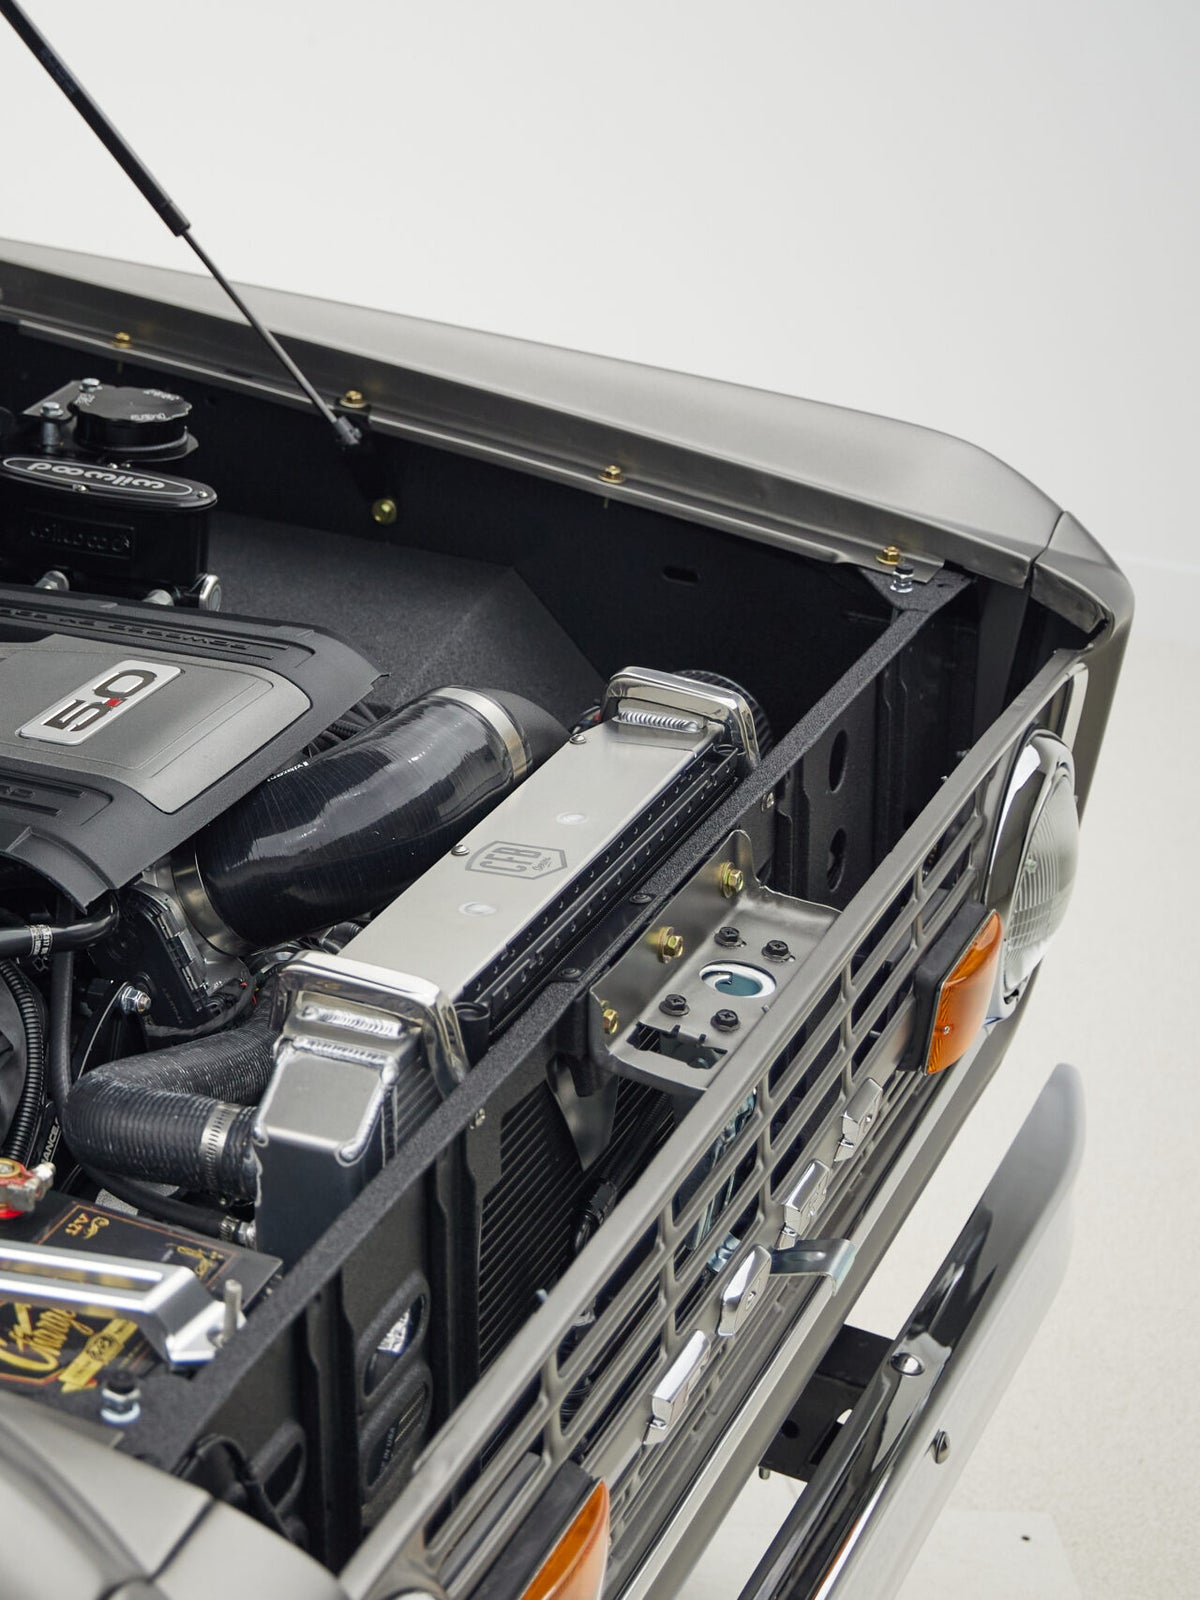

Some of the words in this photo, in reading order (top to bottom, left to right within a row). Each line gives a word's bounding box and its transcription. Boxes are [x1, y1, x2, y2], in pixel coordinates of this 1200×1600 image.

[27, 461, 166, 490] wilwood
[43, 667, 158, 734] 5.0
[479, 846, 542, 873] CFB
